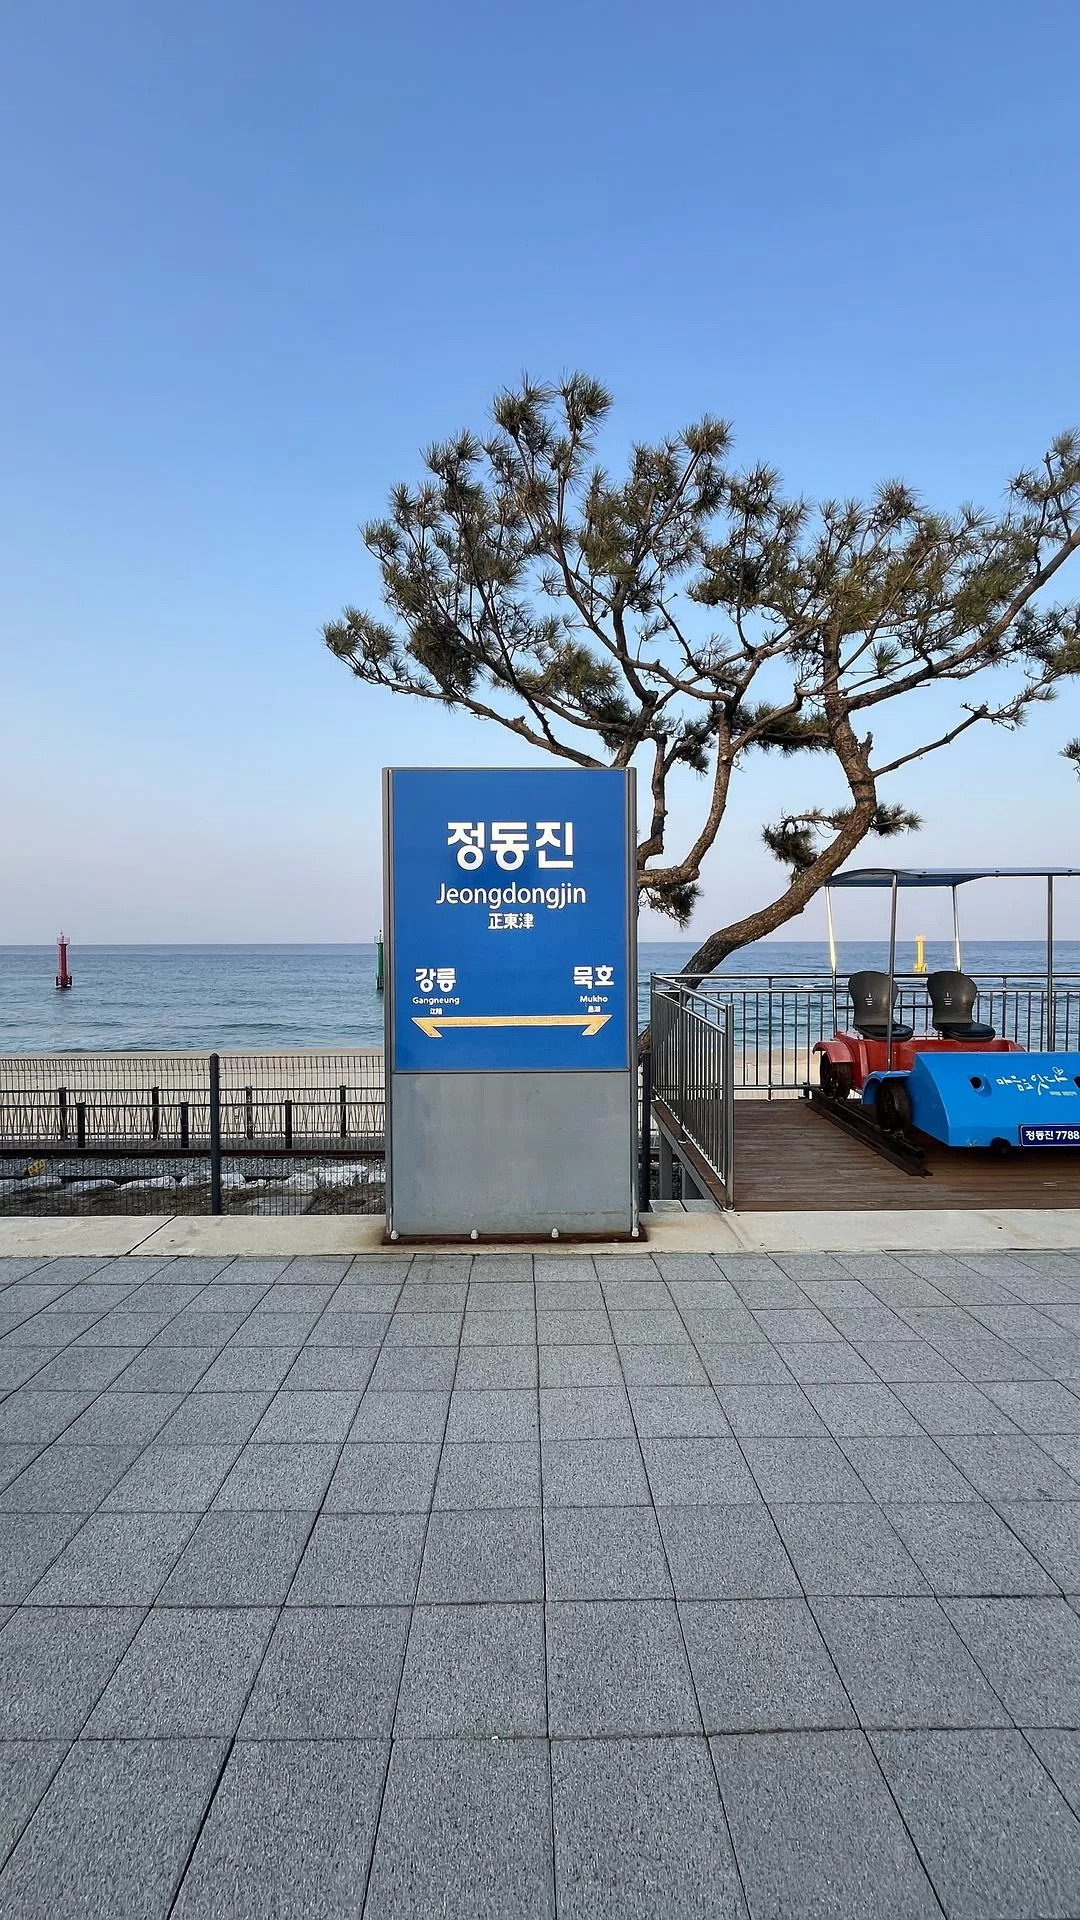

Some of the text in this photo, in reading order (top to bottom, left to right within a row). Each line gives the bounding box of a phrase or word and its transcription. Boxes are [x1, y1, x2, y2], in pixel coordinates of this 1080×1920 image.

[447, 821, 574, 871] 정동진
[436, 881, 586, 909] Jeongdongjin
[488, 913, 534, 930] 正東津
[415, 967, 457, 993] 강릉
[573, 964, 615, 990] 묵호
[412, 996, 460, 1006] Gangneung
[579, 994, 609, 1003] Mukho
[1025, 1130, 1080, 1141] 정동진 7788
